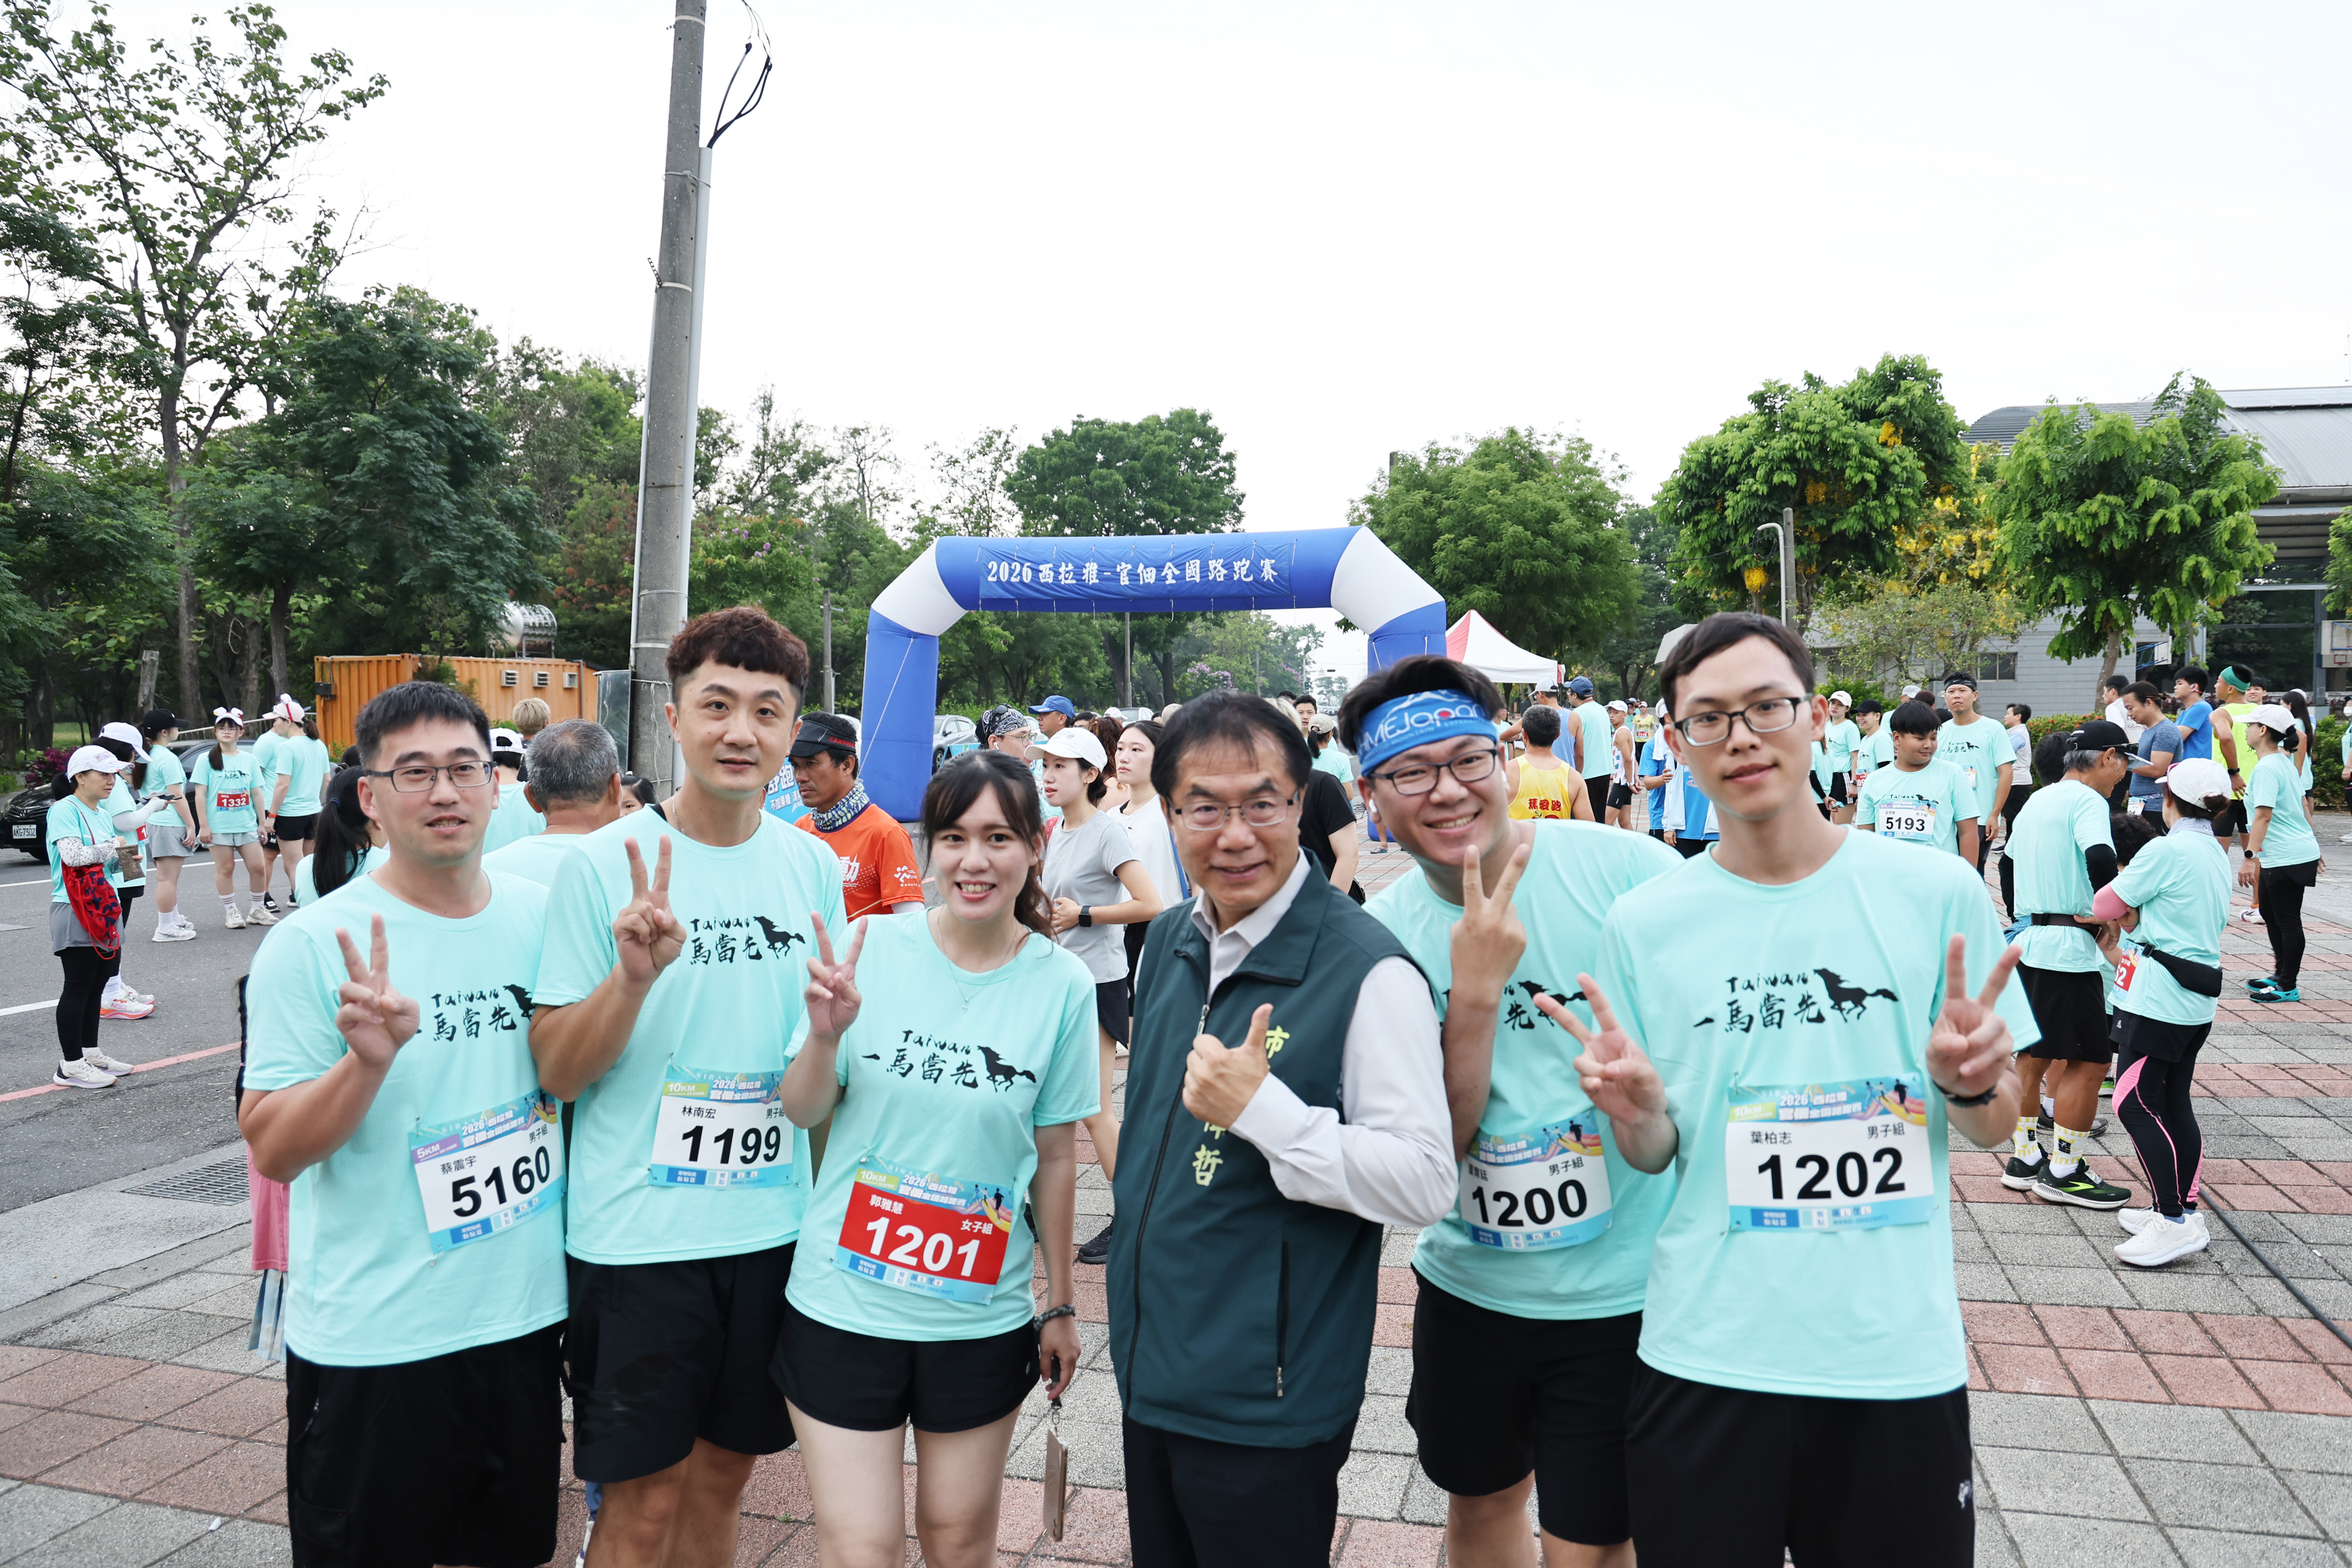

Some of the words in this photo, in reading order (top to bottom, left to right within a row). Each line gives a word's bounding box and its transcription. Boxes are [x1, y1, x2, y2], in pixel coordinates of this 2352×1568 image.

[221, 798, 247, 807] 1332
[1528, 798, 1562, 811] 蕉愛跑
[1886, 817, 1925, 831] 5193
[690, 917, 750, 933] Taiwan
[679, 933, 762, 965] 馬當先
[1726, 972, 1809, 994] Taiwan
[431, 988, 499, 1008] Taiwan
[1693, 991, 1826, 1033] 一馬當先
[416, 1004, 517, 1041] 馬當先
[901, 1030, 971, 1055] Taiwan
[861, 1048, 978, 1089] 一馬當先
[668, 1083, 695, 1092] 10KM
[713, 1080, 736, 1090] 2026
[1780, 1094, 1808, 1106] 2026
[681, 1105, 716, 1119] 林南宏
[1734, 1105, 1762, 1118] 10KM
[462, 1119, 485, 1136] 2026
[529, 1125, 548, 1144] 男子組
[1867, 1123, 1905, 1139] 男子組
[682, 1125, 780, 1164] 1199
[1750, 1131, 1792, 1145] 葉柏志
[417, 1144, 440, 1159] 5KM
[440, 1155, 476, 1175] 蔡震宇
[1549, 1156, 1584, 1176] 男子組
[1758, 1147, 1906, 1200] 1202
[452, 1146, 550, 1217] 5160
[860, 1170, 887, 1182] 10KM
[903, 1174, 927, 1187] 2026
[869, 1194, 904, 1215] 郭雅慧
[1472, 1180, 1587, 1227] 1200
[961, 1219, 993, 1234] 女子組
[866, 1217, 980, 1277] 1201
